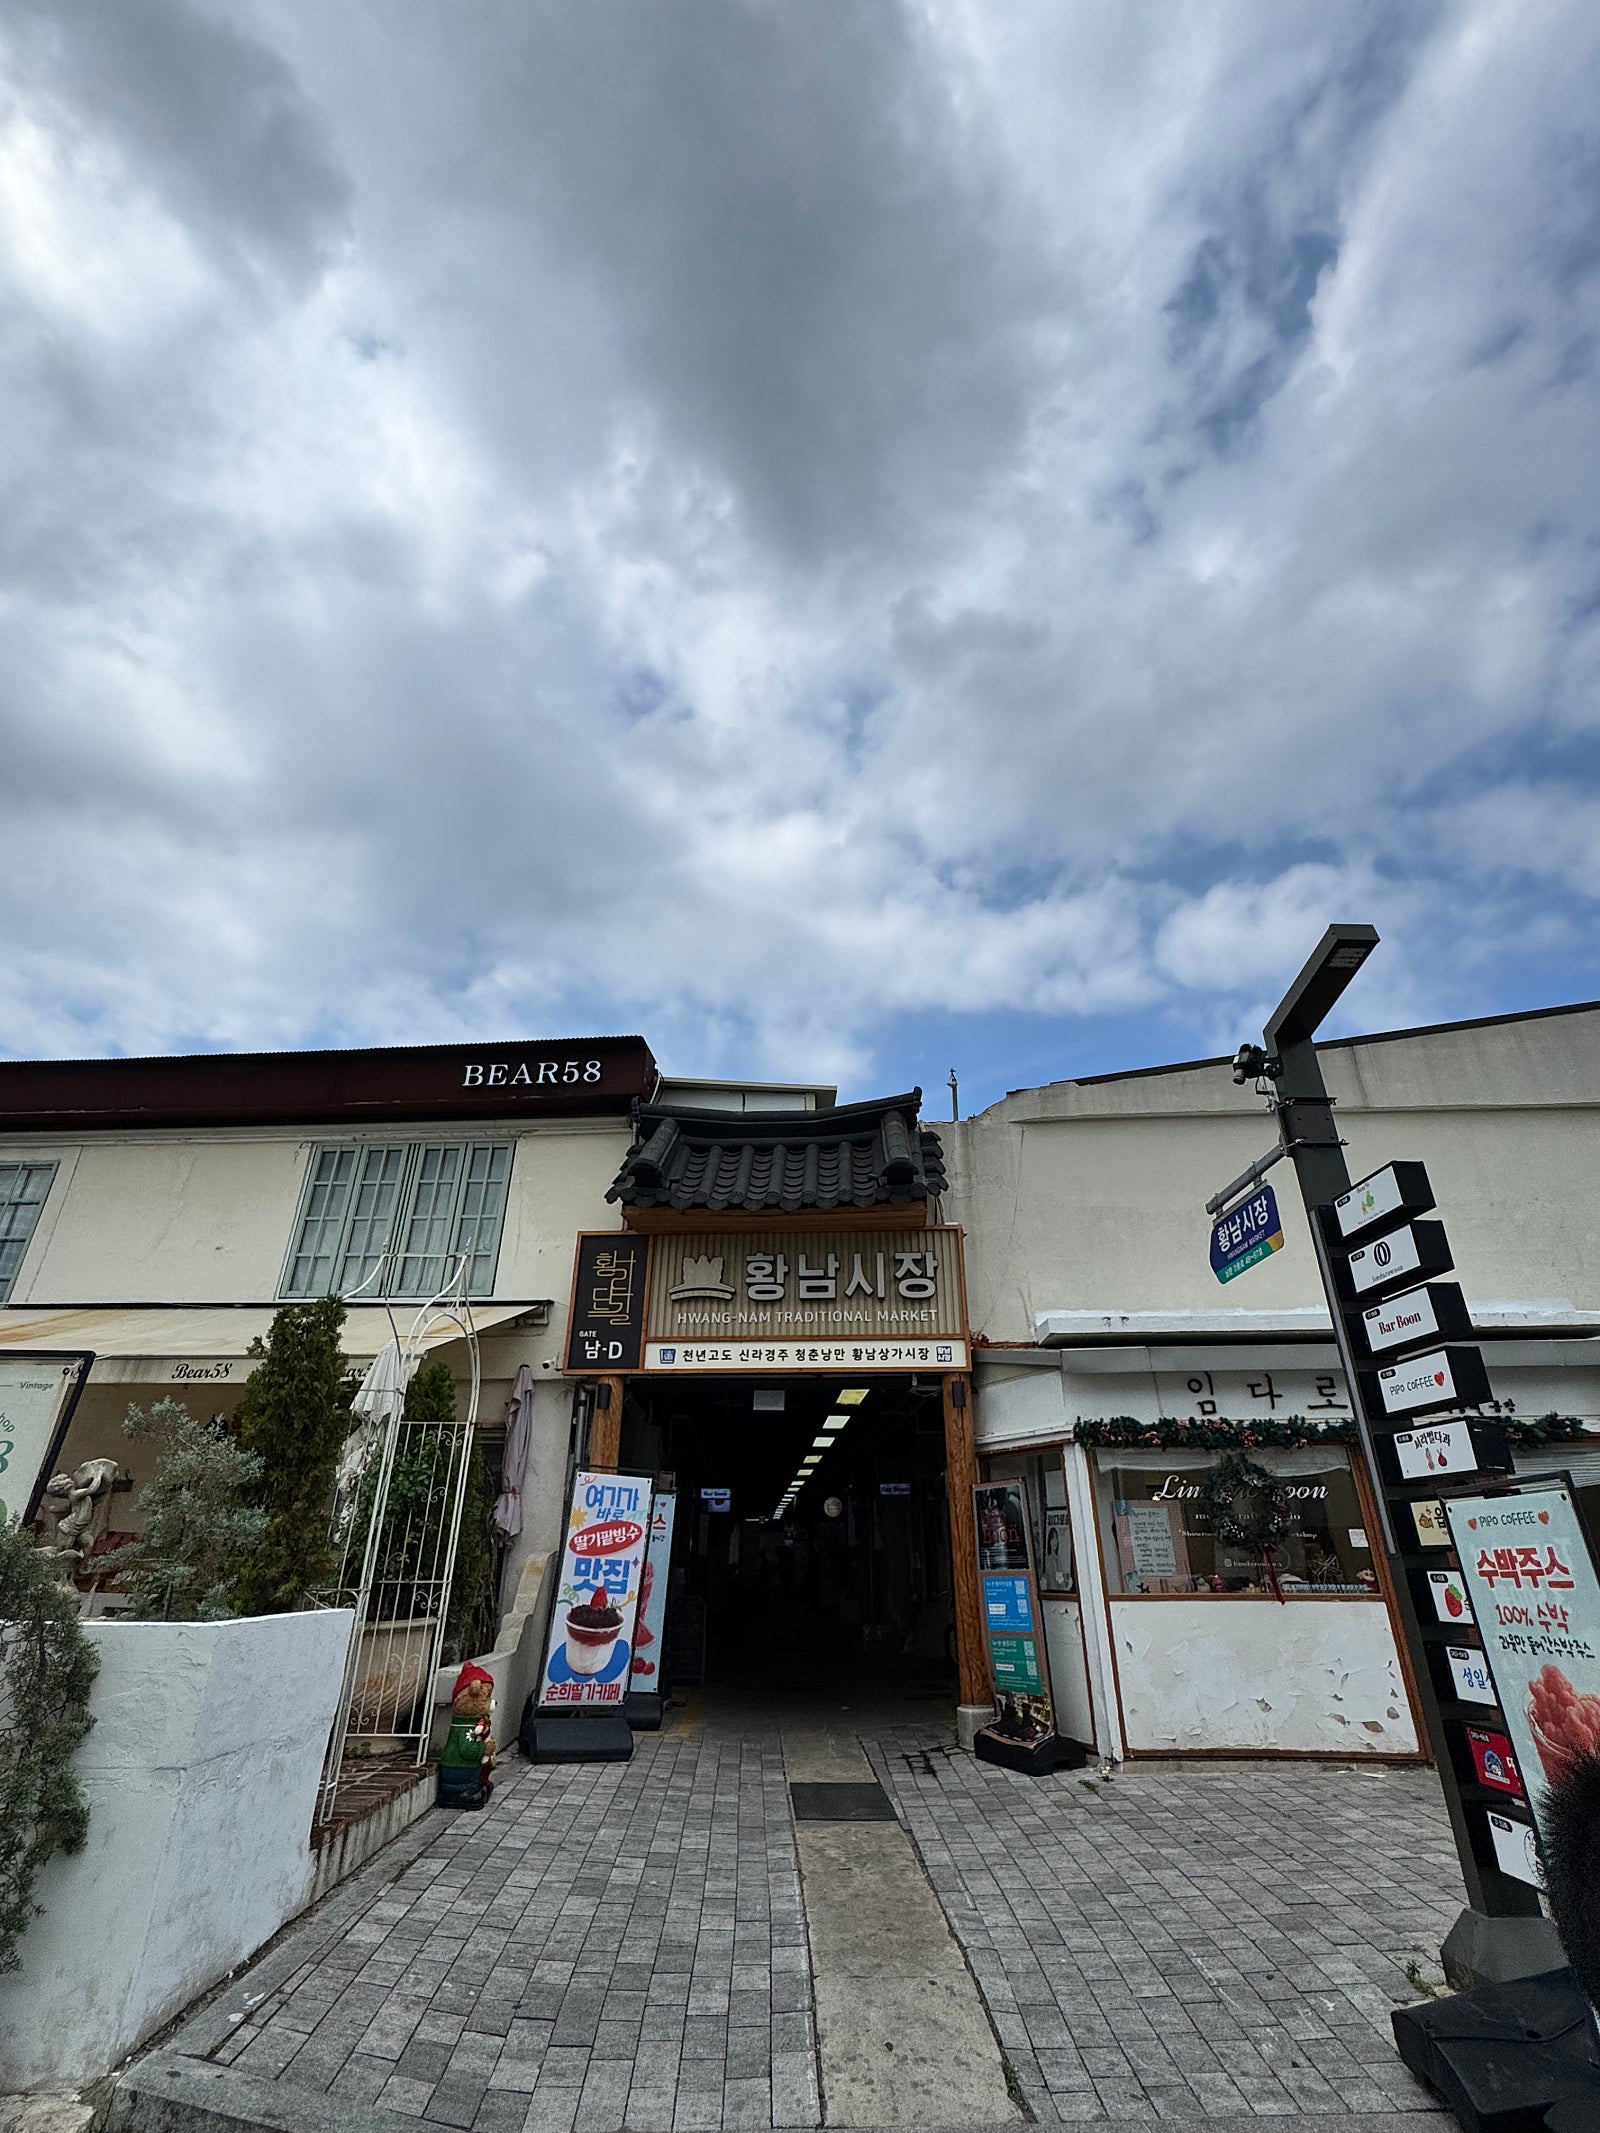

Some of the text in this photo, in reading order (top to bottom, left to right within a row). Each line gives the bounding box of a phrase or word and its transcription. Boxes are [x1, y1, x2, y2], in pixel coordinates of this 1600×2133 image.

[462, 1060, 602, 1087] BEAR58
[1218, 1195, 1269, 1252] 황남시장
[745, 1251, 938, 1301] 황남시장
[677, 1309, 938, 1325] HWANG-NAM TRADITIONAL MARKET
[1378, 1321, 1396, 1335] Bar
[1396, 1312, 1422, 1329] Boon
[579, 1330, 597, 1338] GATE
[585, 1340, 623, 1359] 남-D
[682, 1347, 930, 1363] 천년고도 신라경주 청춘낭만 황남상가시장
[172, 1363, 232, 1379] Bear58
[20, 1381, 54, 1391] Vintage
[585, 1485, 640, 1512] 여기가
[596, 1507, 625, 1522] 바로
[1500, 1511, 1536, 1526] COFFEE
[573, 1525, 640, 1552] 딸기팥빙수
[573, 1557, 630, 1595] 맛집
[1477, 1546, 1575, 1588] 수박주스
[1495, 1601, 1570, 1634] 100% 수박
[545, 1683, 620, 1701] 순희딸기카페
